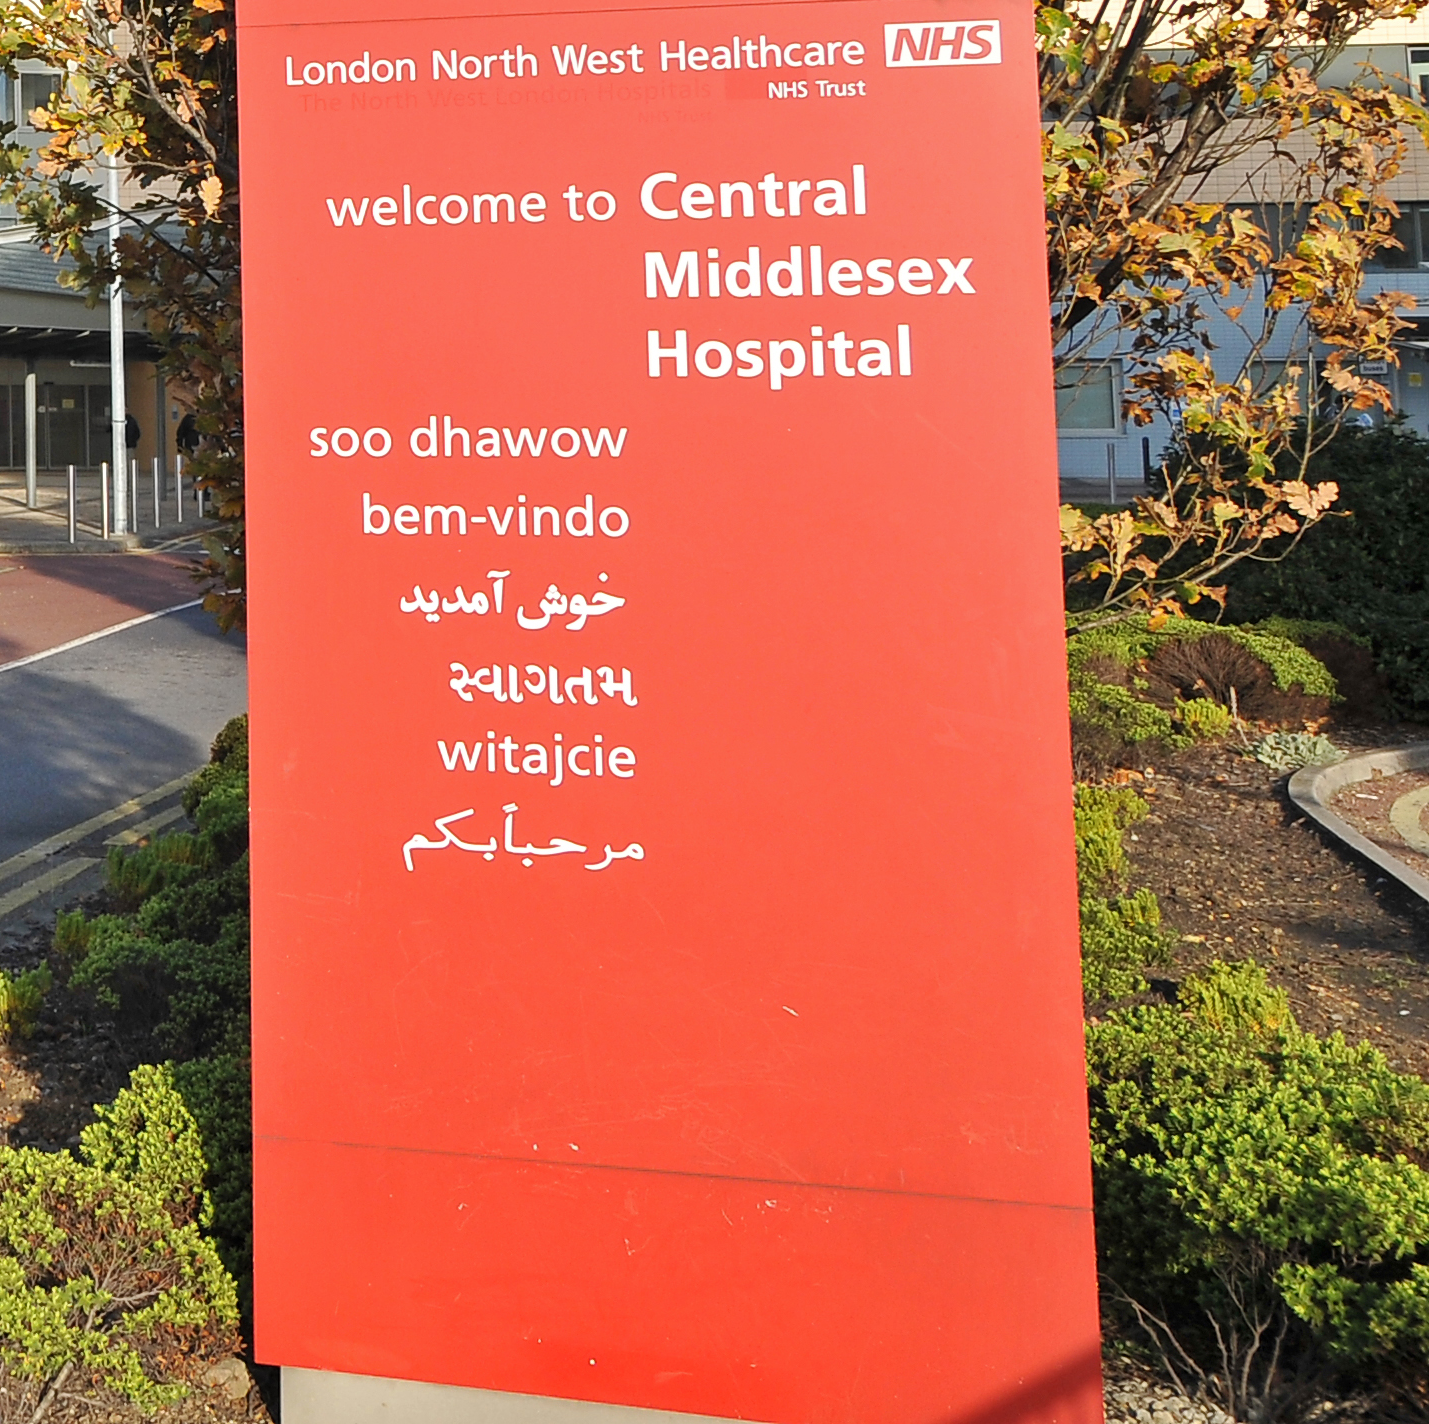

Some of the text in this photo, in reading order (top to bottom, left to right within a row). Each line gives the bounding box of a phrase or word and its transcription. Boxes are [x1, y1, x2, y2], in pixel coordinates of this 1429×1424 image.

[285, 35, 865, 86] London North West Healthcare
[890, 23, 995, 63] NHS
[767, 79, 867, 100] NHS Trust
[325, 163, 868, 228] welcome to Central
[643, 244, 977, 299] Middlesex
[646, 323, 913, 391] Hospital
[308, 414, 628, 459] soo dhawow
[362, 491, 630, 539] bem-vindo
[516, 571, 626, 631] خوش
[436, 729, 638, 787] witajcie
